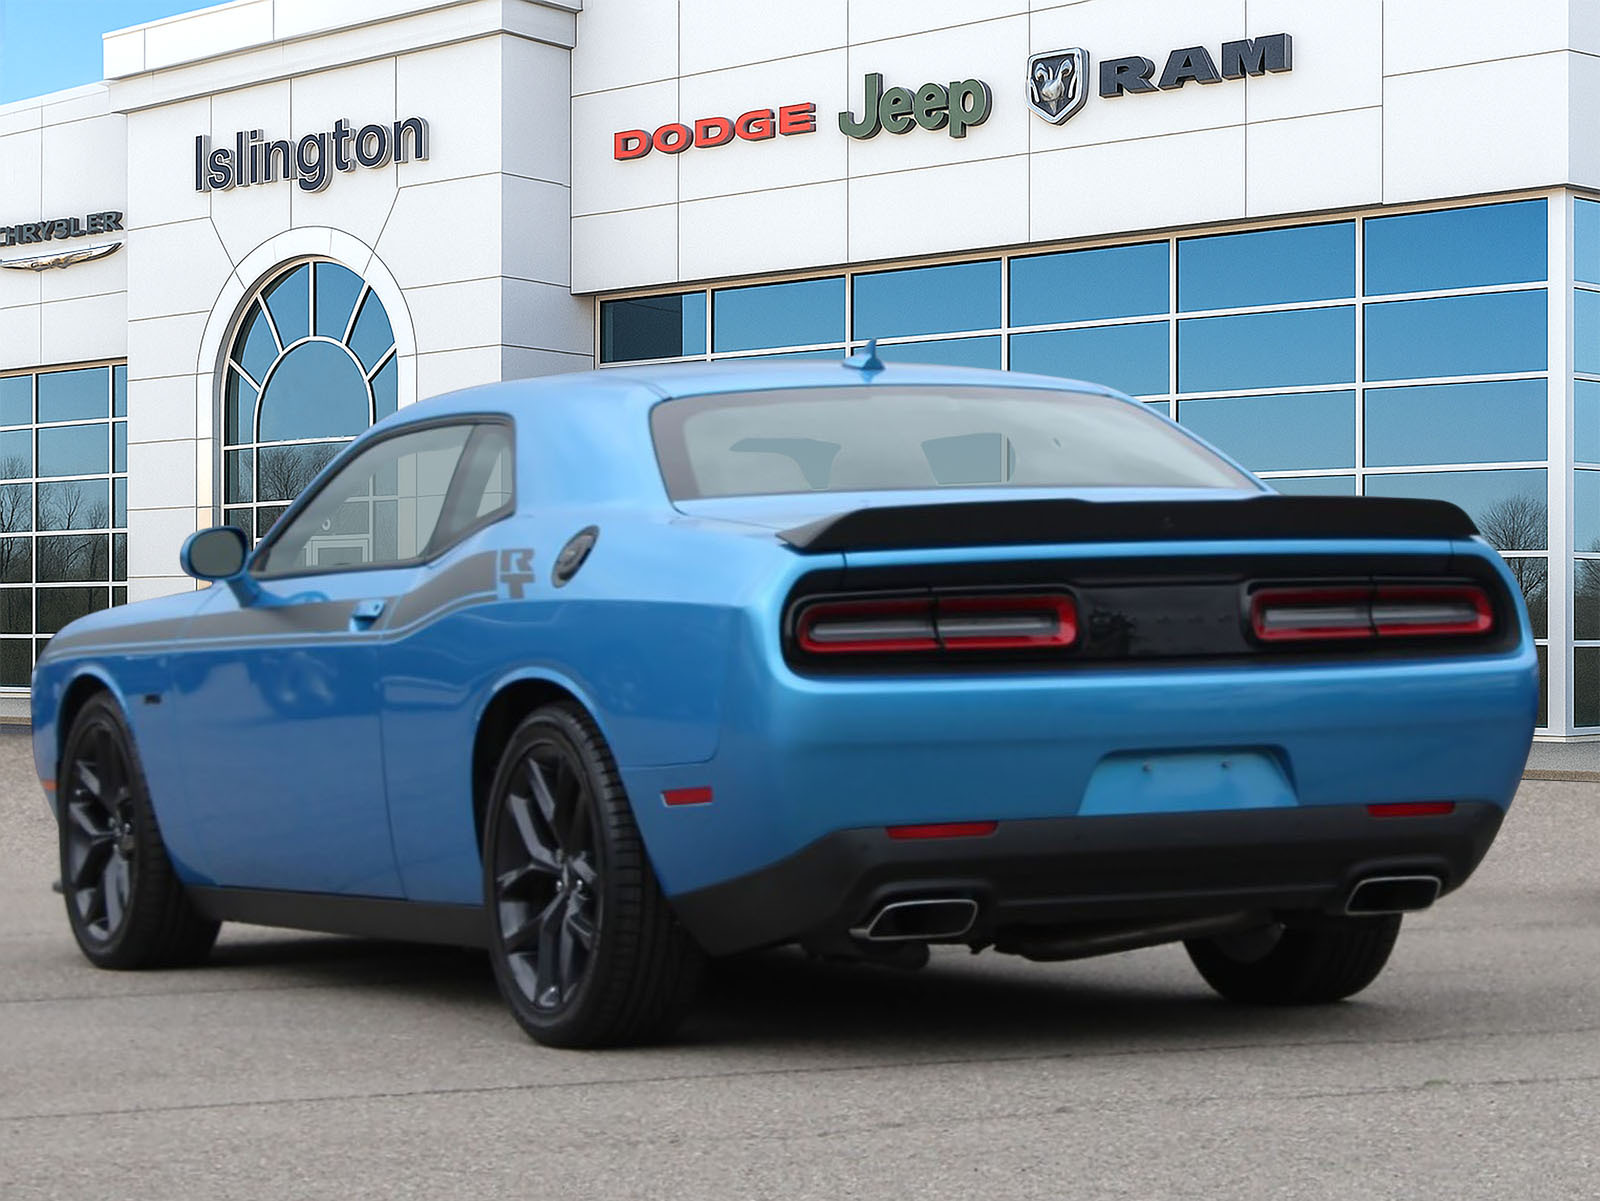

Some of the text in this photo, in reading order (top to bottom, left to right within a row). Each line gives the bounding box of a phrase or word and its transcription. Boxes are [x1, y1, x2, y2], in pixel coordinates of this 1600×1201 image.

[614, 32, 1293, 161] DODGE Jeep RAM
[195, 116, 430, 192] Islington
